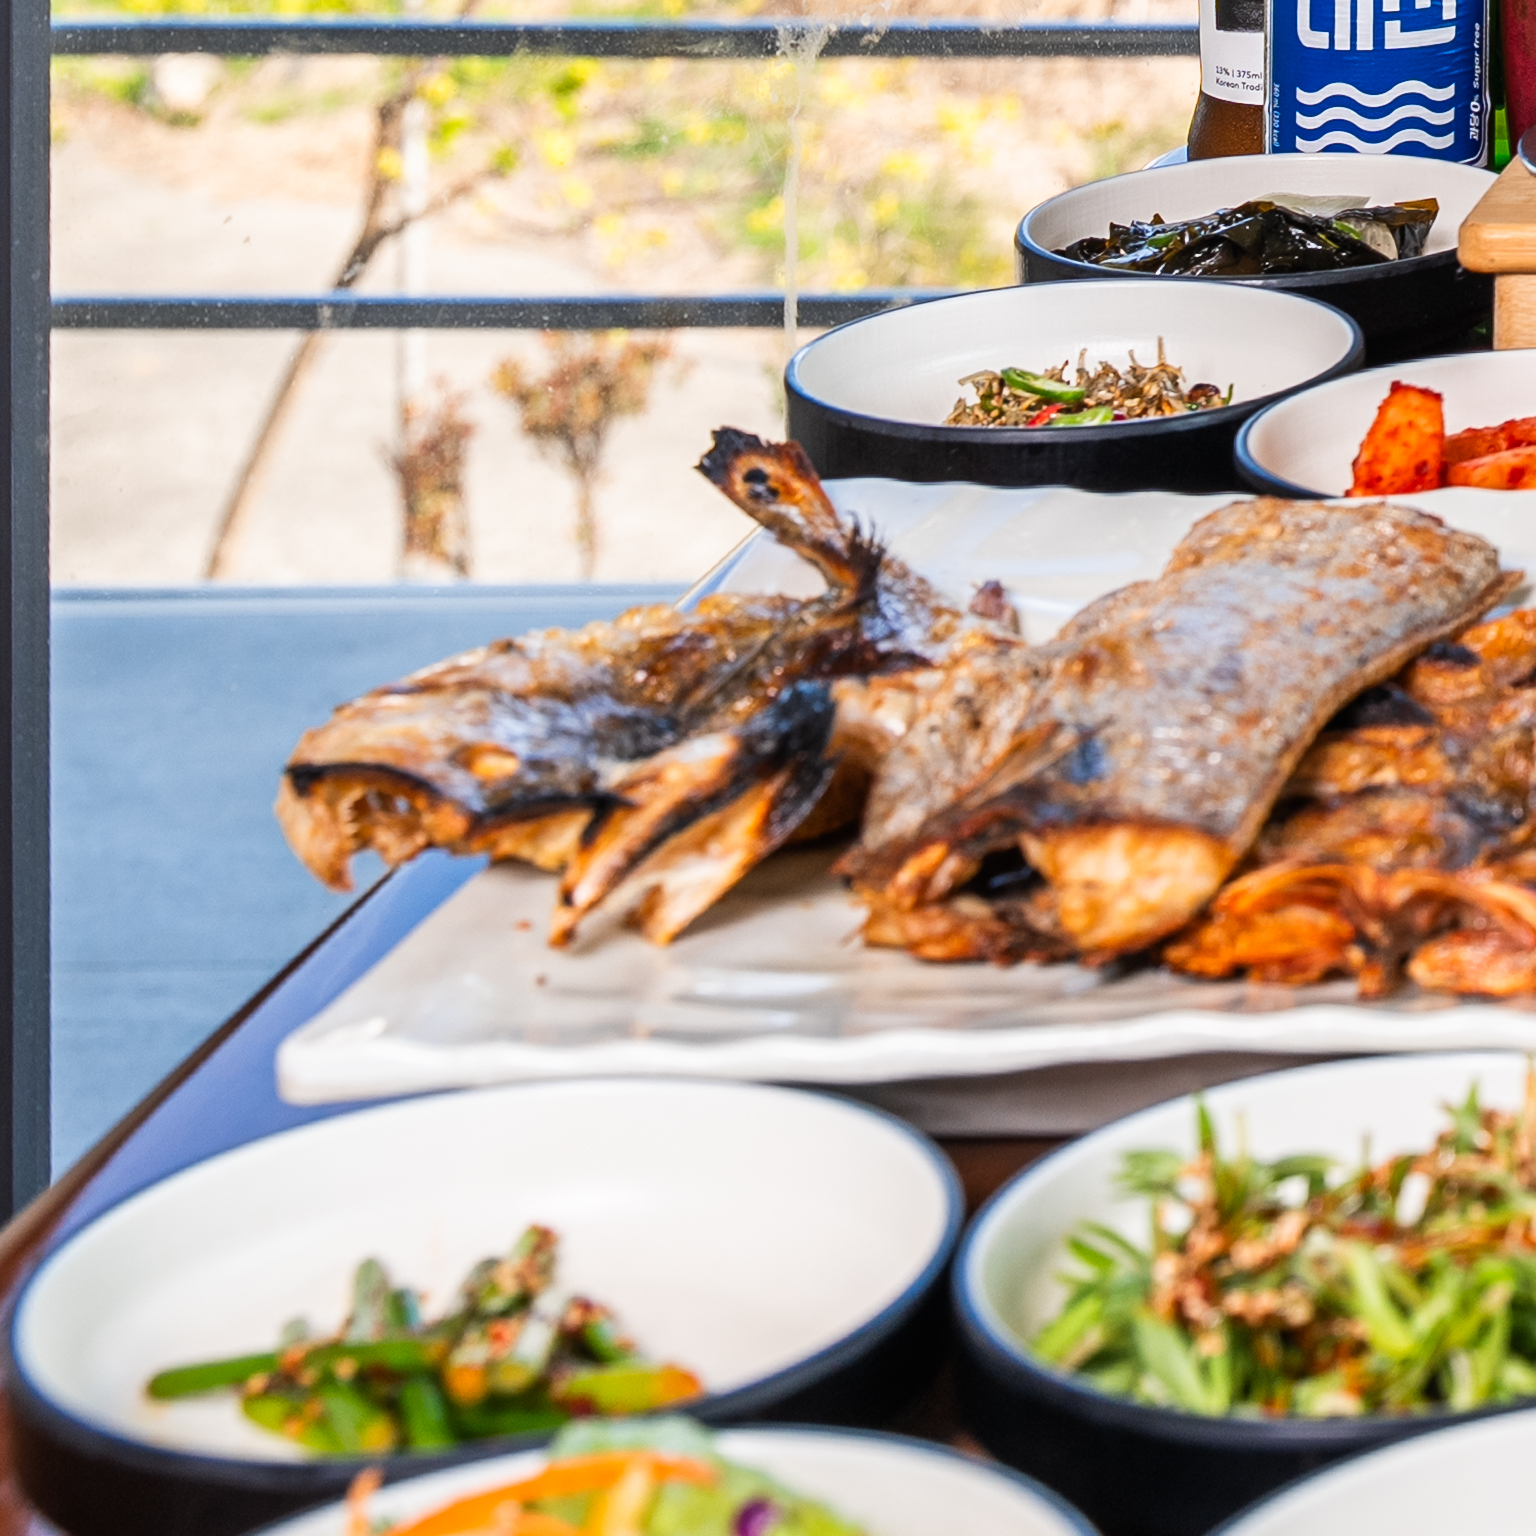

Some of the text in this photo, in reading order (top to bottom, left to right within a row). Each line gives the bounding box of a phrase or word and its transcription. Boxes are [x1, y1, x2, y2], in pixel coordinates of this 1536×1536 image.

[1473, 22, 1482, 50] free
[1215, 65, 1230, 76] 13%
[1472, 50, 1482, 90] Sugar
[1215, 77, 1240, 89] Korean
[1273, 82, 1281, 97] 360
